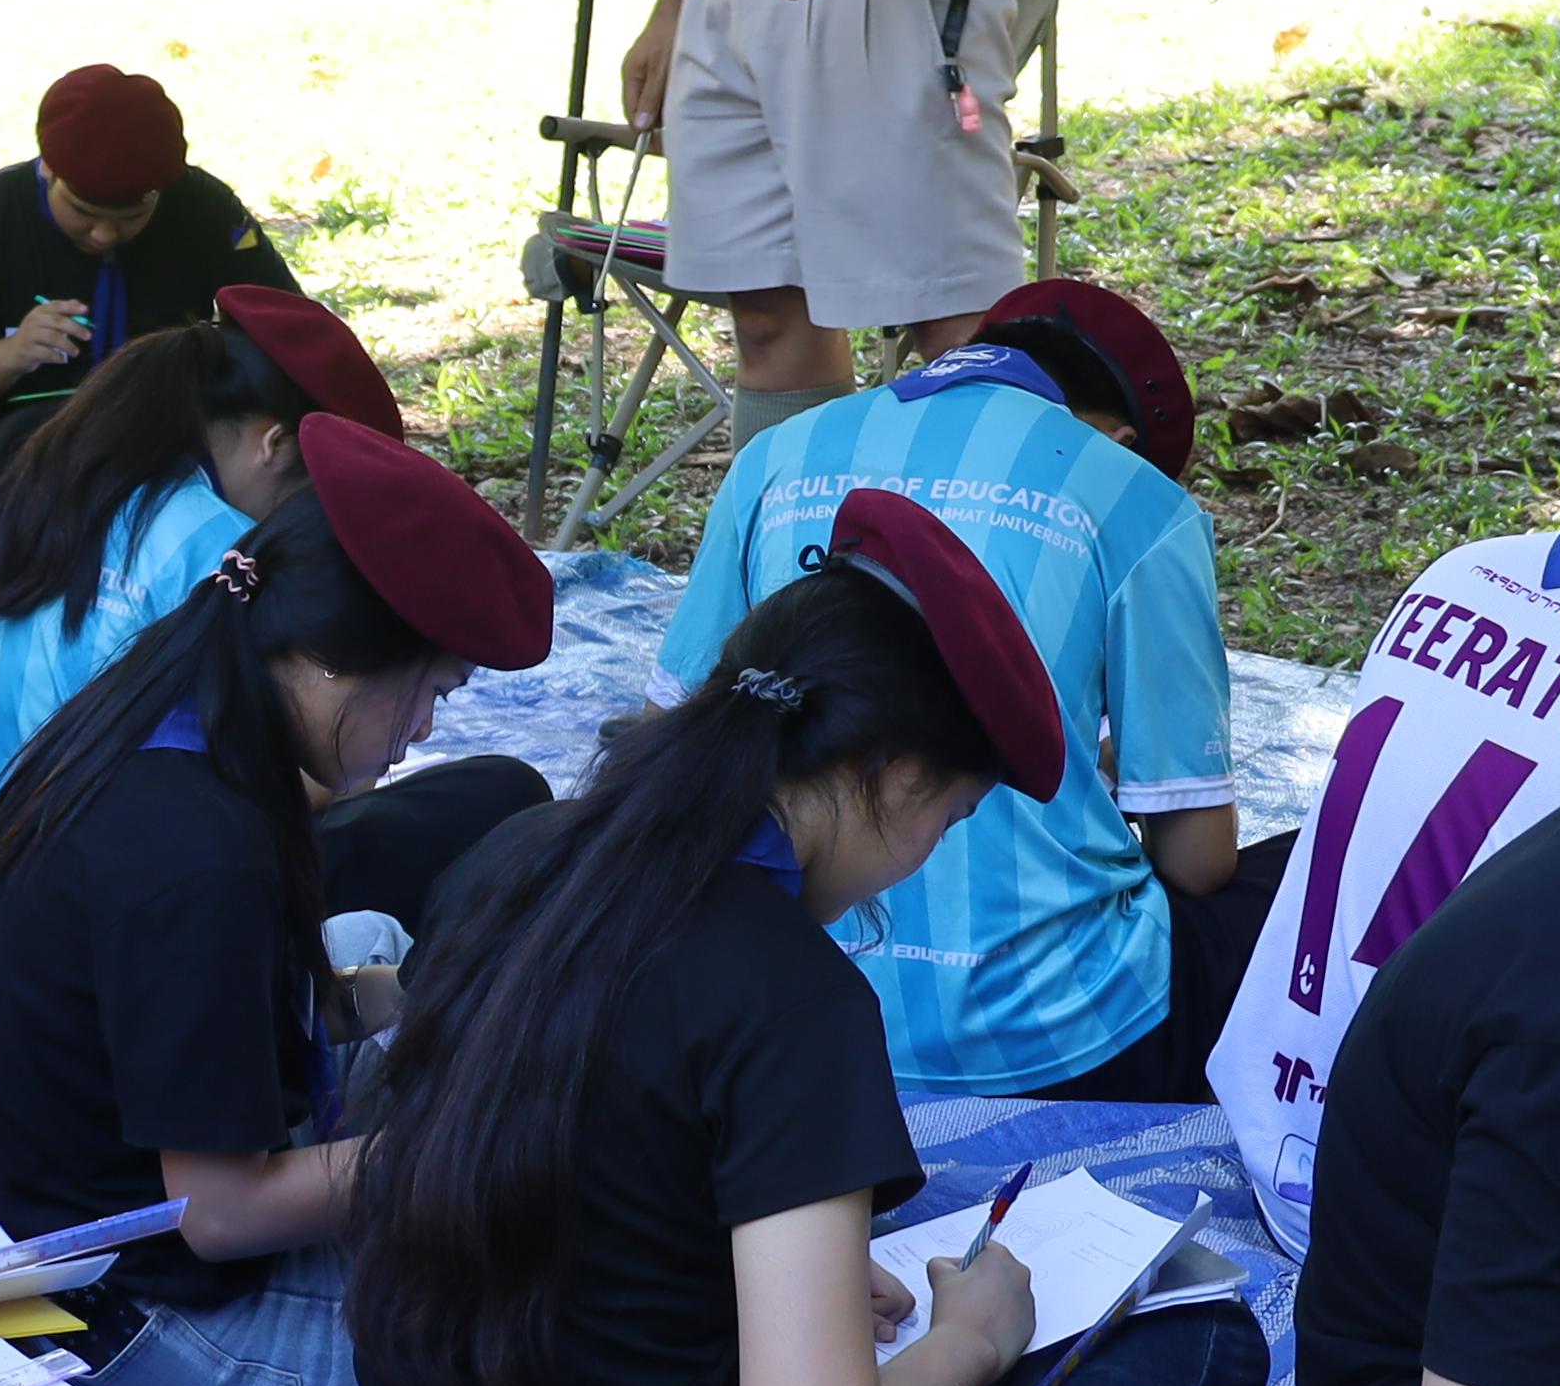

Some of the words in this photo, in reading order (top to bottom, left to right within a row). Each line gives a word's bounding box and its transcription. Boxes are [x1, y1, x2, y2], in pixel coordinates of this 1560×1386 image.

[761, 474, 871, 512] FACULTY
[881, 476, 923, 499] OF
[929, 479, 1100, 539] EDUCATION
[989, 511, 1088, 558] UNIVERSITY
